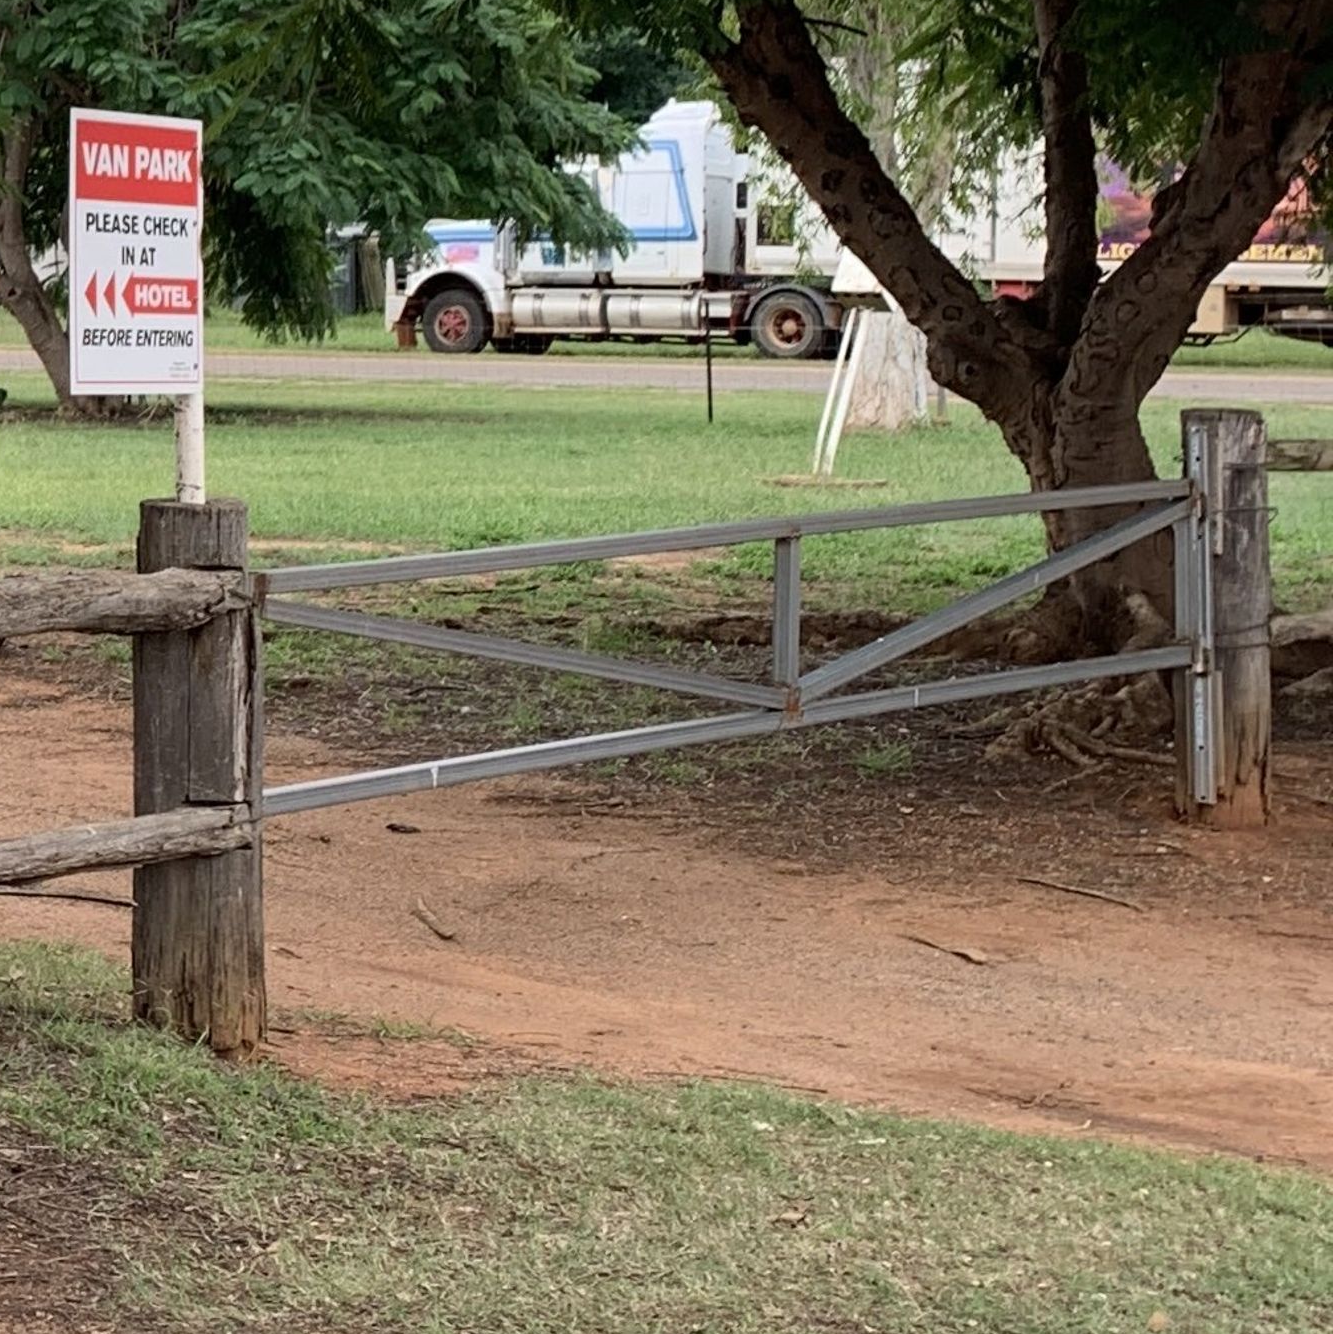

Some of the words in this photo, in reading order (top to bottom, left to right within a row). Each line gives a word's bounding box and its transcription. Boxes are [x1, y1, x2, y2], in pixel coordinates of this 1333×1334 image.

[82, 141, 129, 178] VAN
[135, 146, 193, 183] PARK
[86, 212, 139, 235] PLEASE
[143, 216, 188, 237] CHECK
[121, 246, 135, 266] IN
[139, 247, 156, 267] AT
[134, 285, 192, 308] HOTEL
[82, 328, 132, 347] BEFORE
[135, 329, 194, 348] ENTERING
